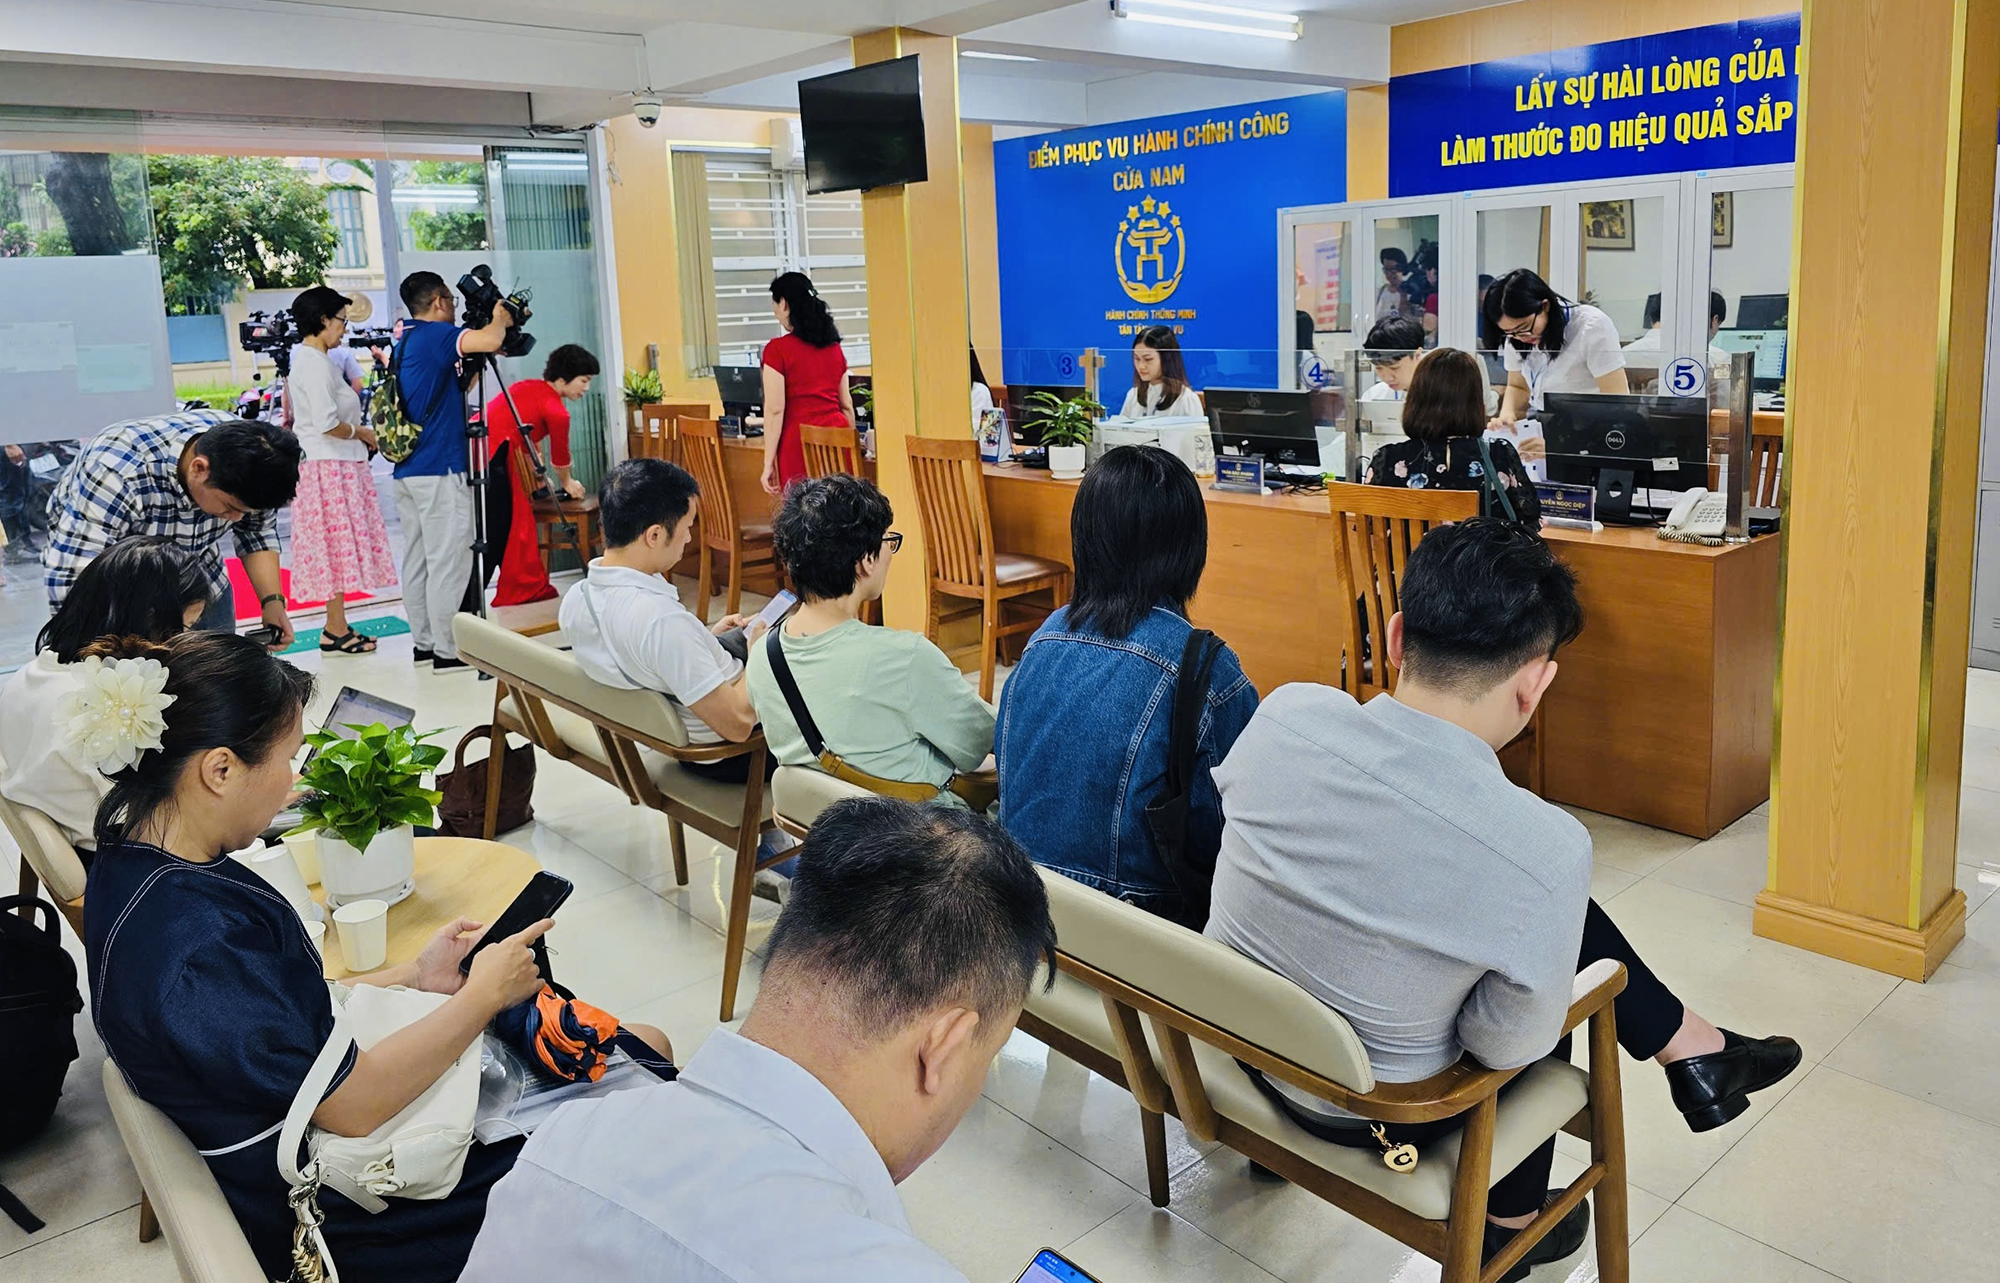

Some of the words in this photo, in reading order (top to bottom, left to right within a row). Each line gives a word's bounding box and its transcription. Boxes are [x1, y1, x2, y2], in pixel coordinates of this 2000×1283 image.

[1515, 73, 1557, 112] LẤY
[1563, 72, 1599, 108] SỰ
[1602, 64, 1644, 100] HÀI
[1652, 55, 1720, 93] LÒNG
[1729, 38, 1786, 83] CỦA
[1029, 141, 1060, 169] ĐIỂM
[1064, 140, 1102, 166] PHỤC
[1107, 136, 1129, 161] VỤ
[1134, 128, 1178, 155] HÀNH
[1184, 119, 1233, 148] CHÍNH
[1240, 110, 1289, 140] CÔNG
[1441, 134, 1486, 166] LÀM
[1491, 122, 1564, 161] THƯỚC
[1570, 123, 1602, 153] ĐO
[1609, 112, 1666, 151] HIỆU
[1674, 96, 1728, 145] QUẢ
[1736, 93, 1794, 135] SẮP
[1113, 165, 1144, 192] CỬA
[1150, 164, 1185, 187] NAM
[1061, 357, 1074, 375] 3
[1308, 362, 1324, 383] 4
[1674, 364, 1696, 390] 5
[1393, 1151, 1413, 1166] C
